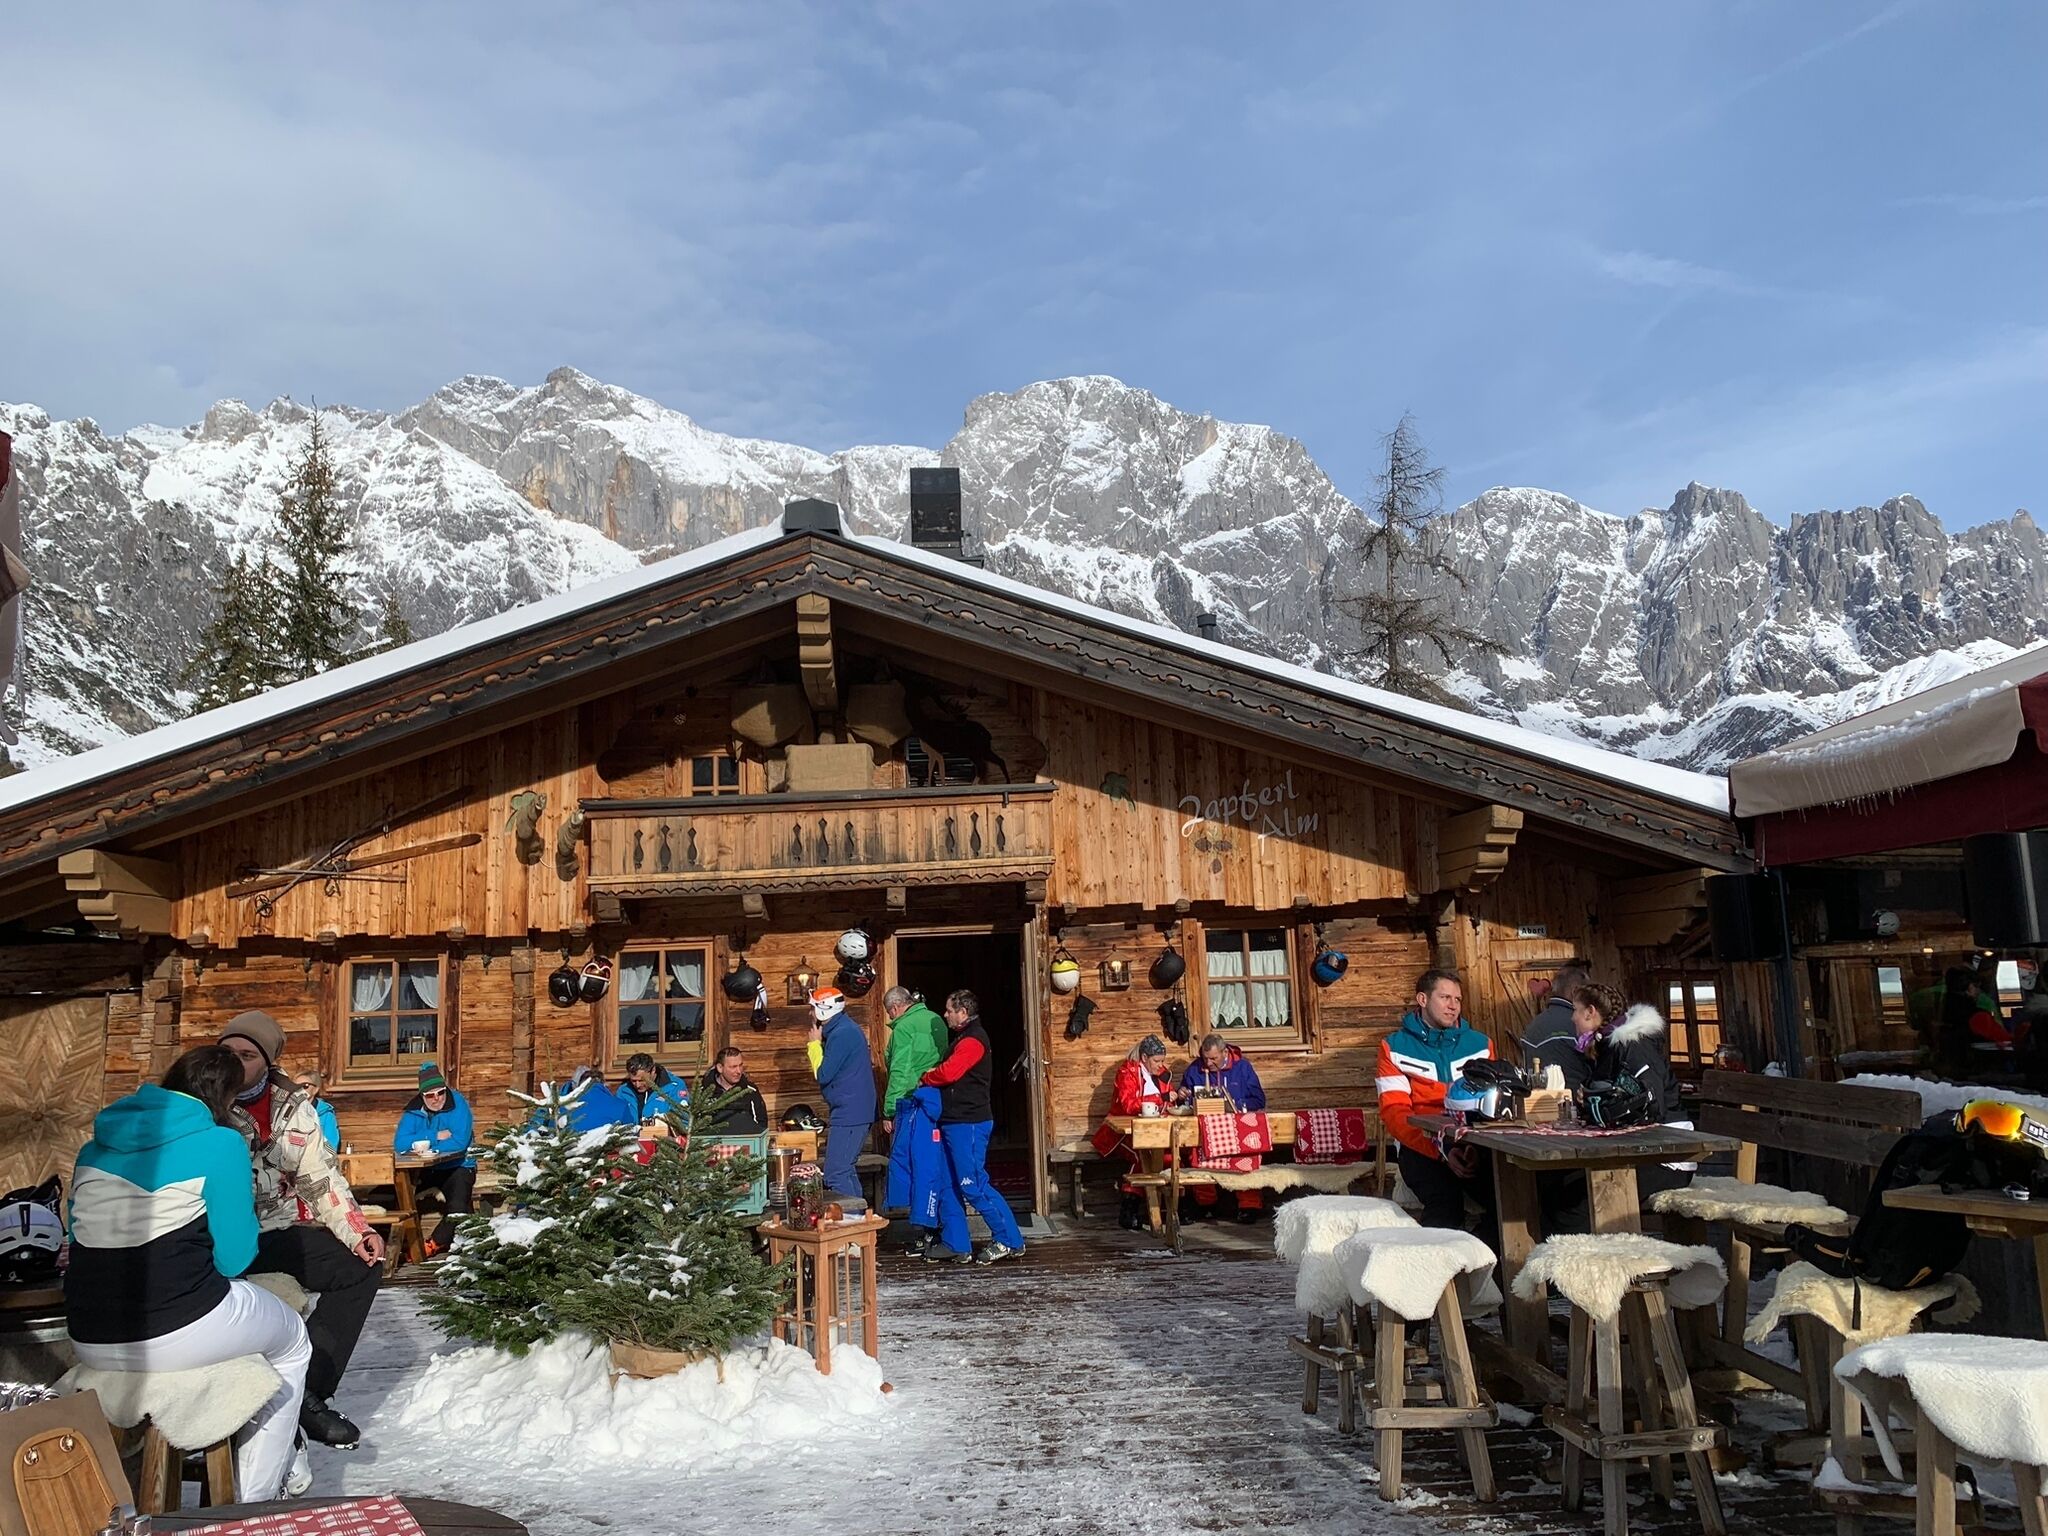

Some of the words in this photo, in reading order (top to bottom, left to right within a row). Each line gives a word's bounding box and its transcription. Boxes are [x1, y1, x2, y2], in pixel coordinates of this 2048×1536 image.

[1178, 768, 1299, 838] Zapferl
[1257, 807, 1319, 857] Alm
[1521, 927, 1545, 935] Abort
